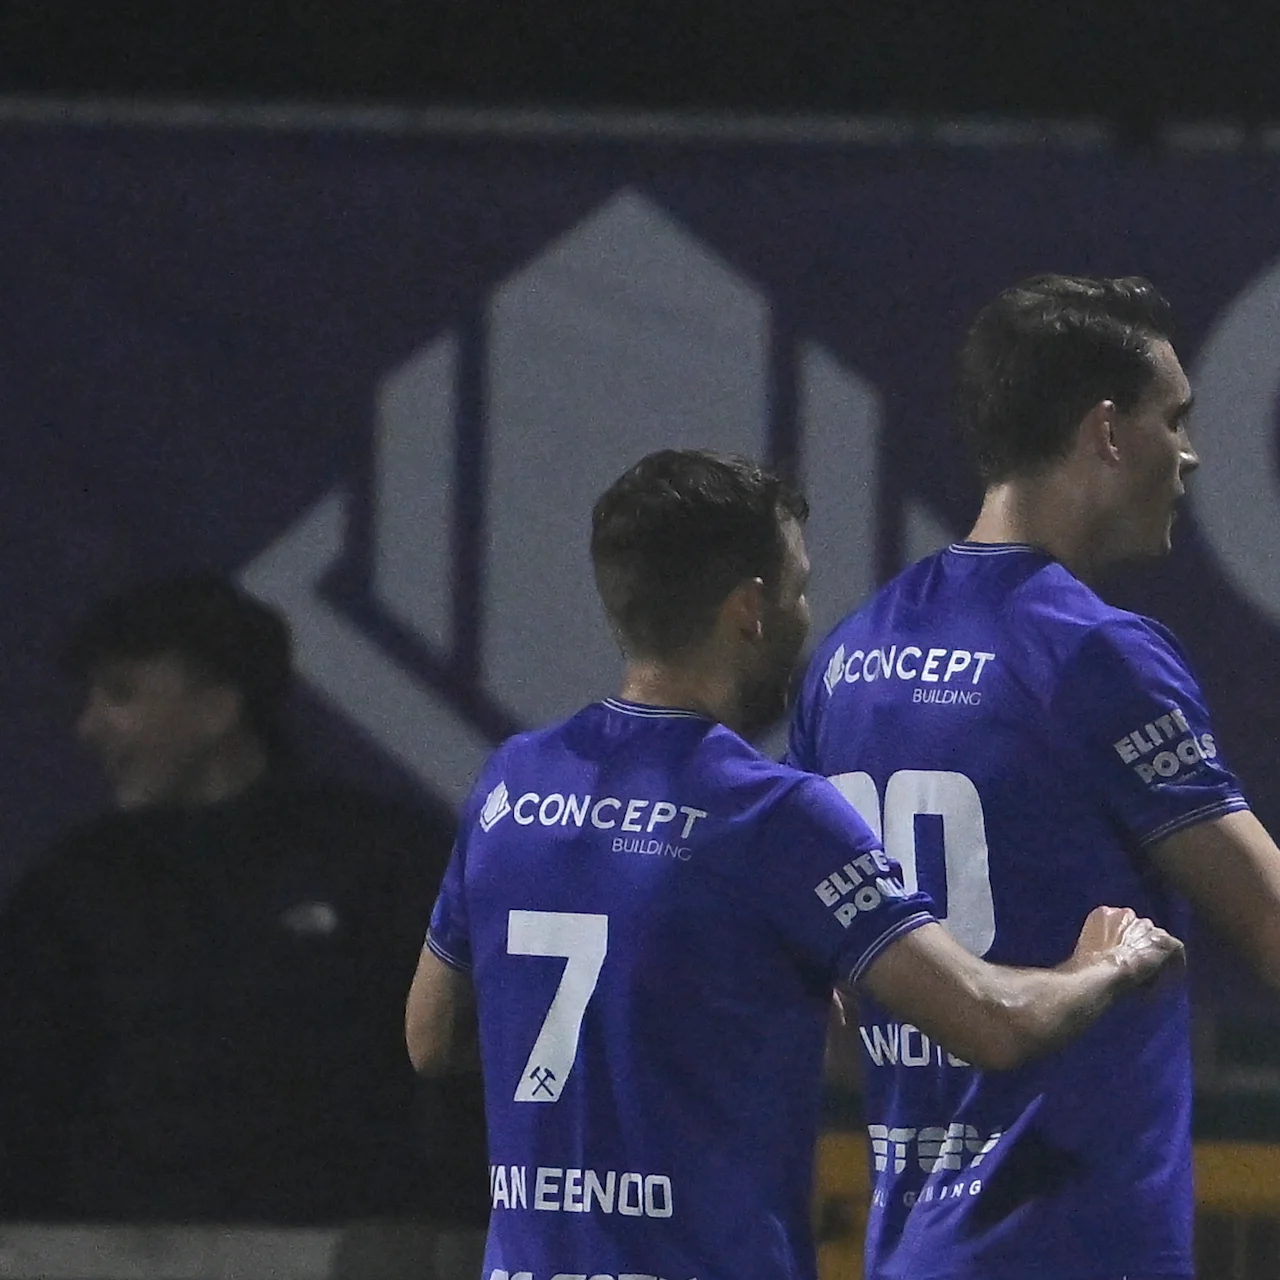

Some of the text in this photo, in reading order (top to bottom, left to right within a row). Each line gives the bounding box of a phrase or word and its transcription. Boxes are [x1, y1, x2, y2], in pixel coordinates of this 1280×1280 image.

[842, 645, 995, 685] CONCEPT
[912, 687, 982, 706] BUILDING
[513, 792, 708, 839] CONCEPT
[612, 837, 692, 862] BUILDING
[814, 849, 890, 907] ELITE
[507, 909, 608, 1103] 7
[534, 1166, 673, 1218] EENOO
